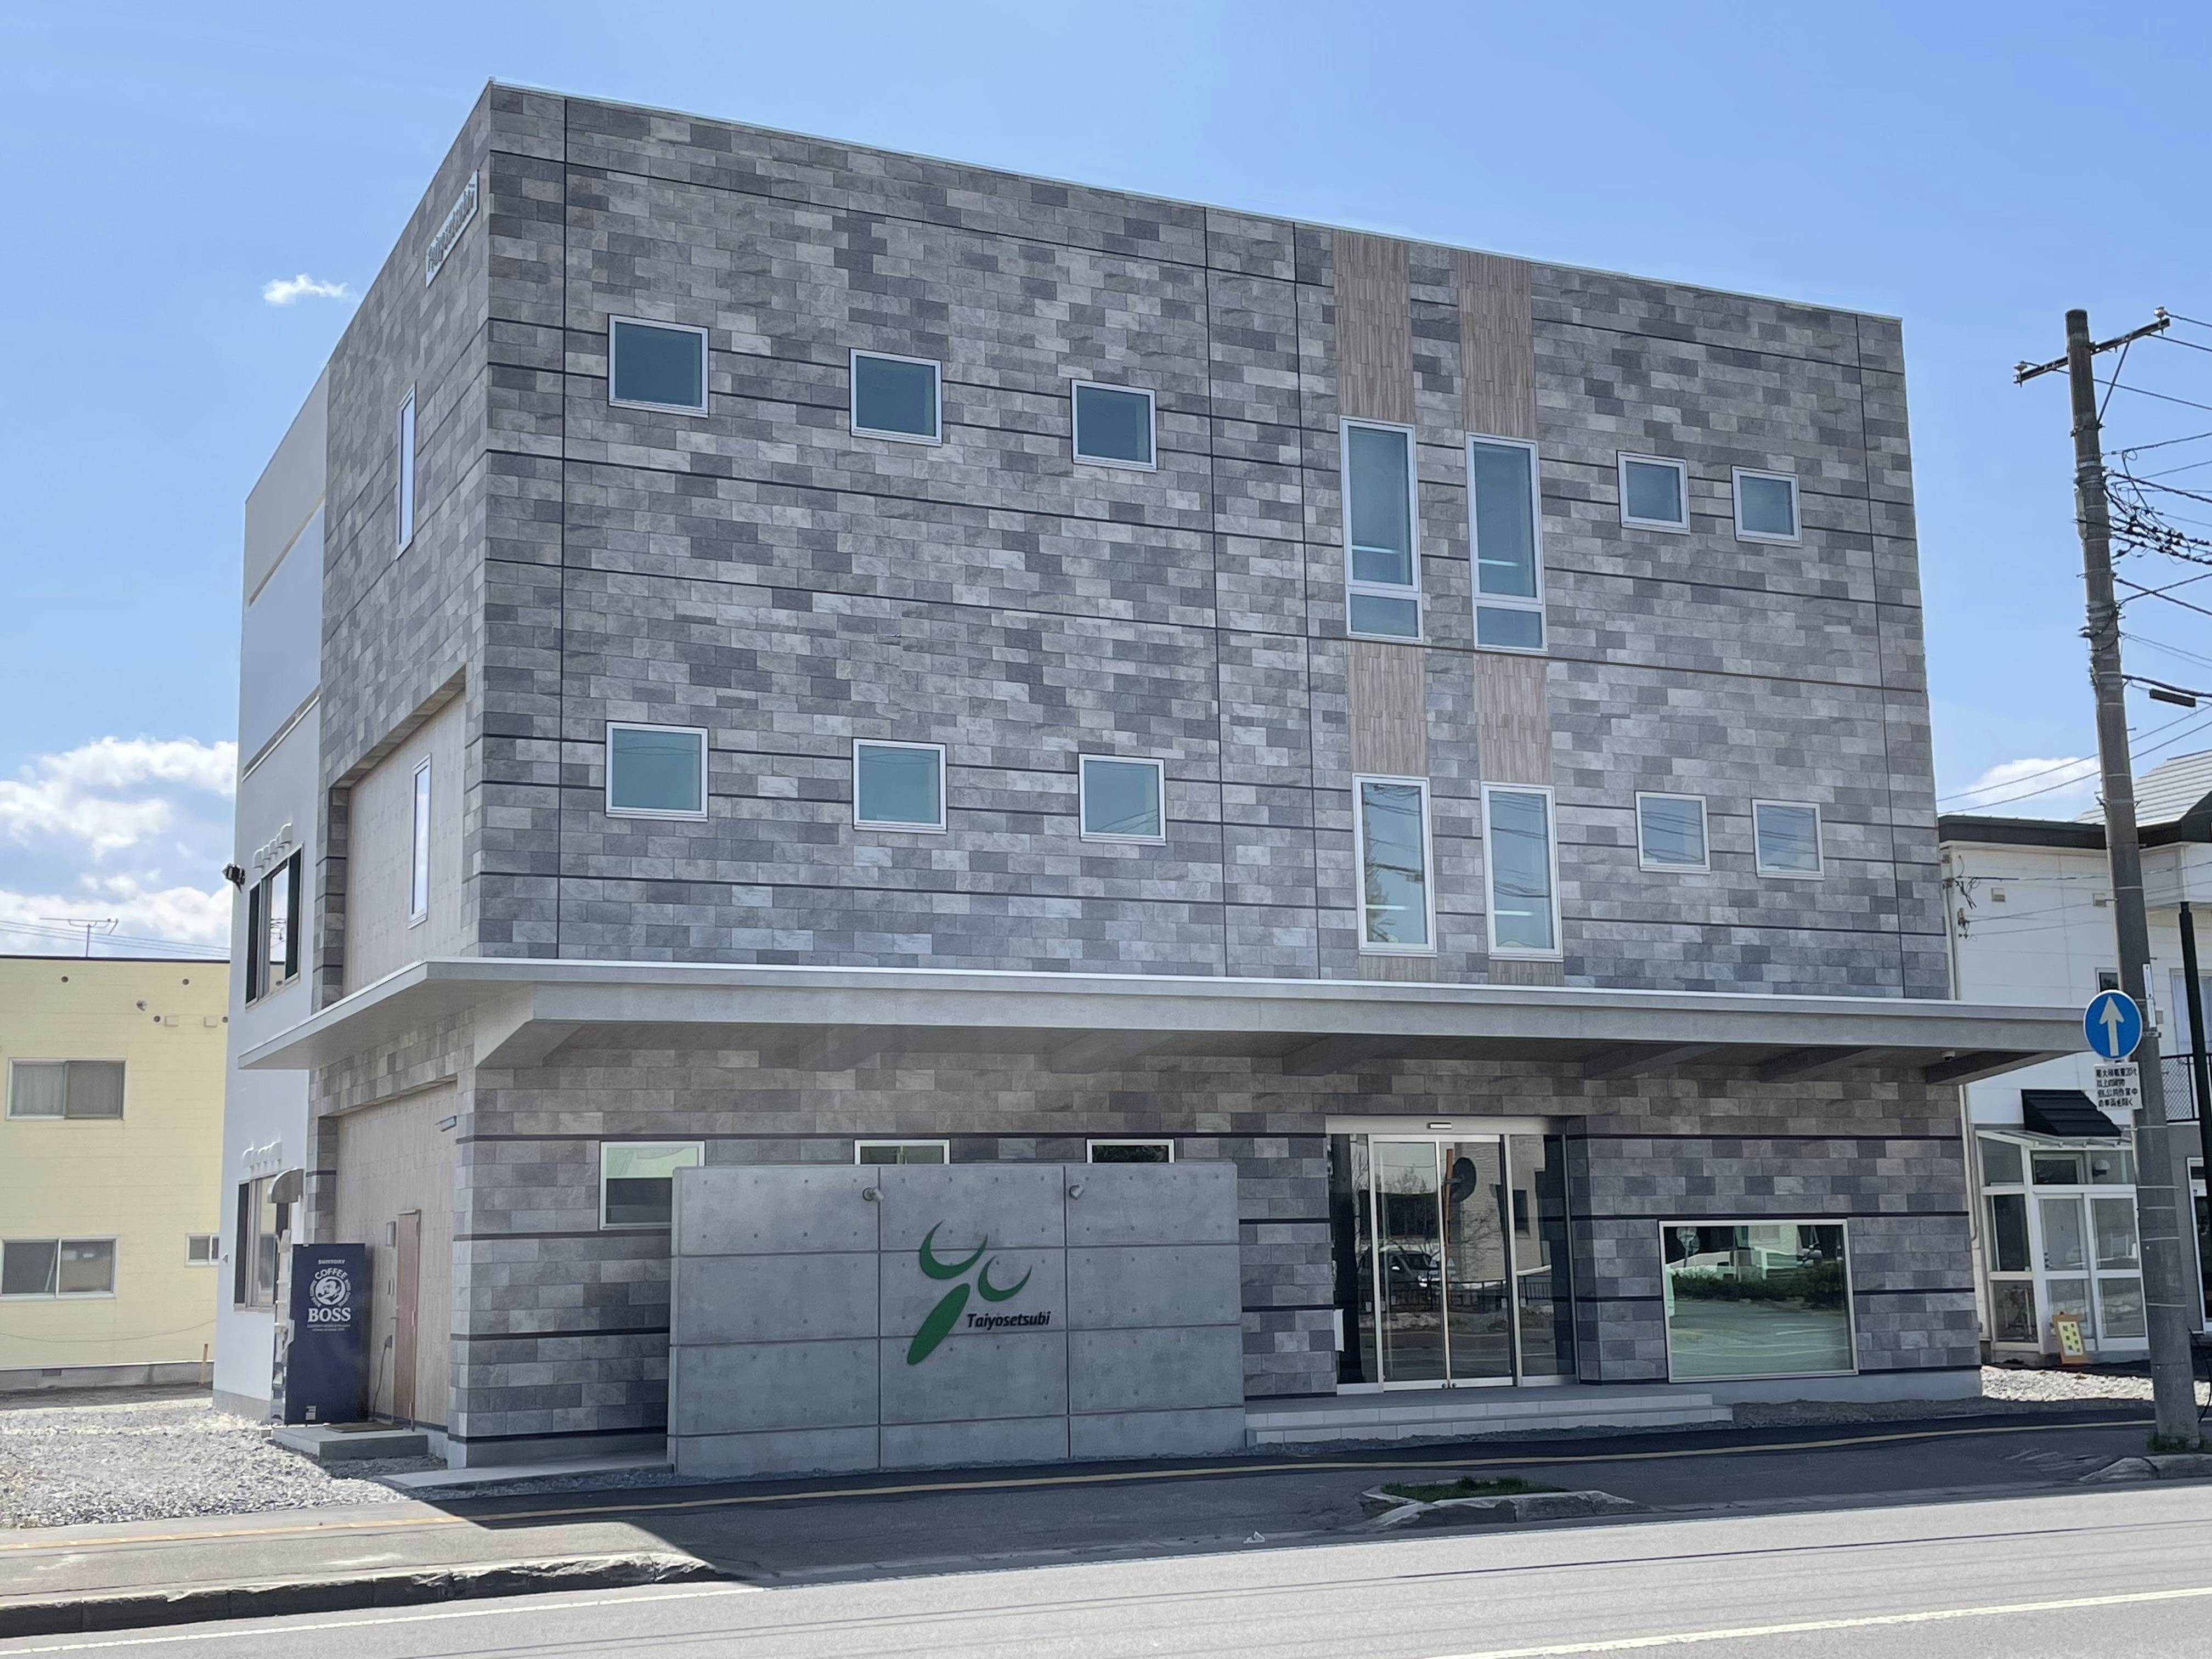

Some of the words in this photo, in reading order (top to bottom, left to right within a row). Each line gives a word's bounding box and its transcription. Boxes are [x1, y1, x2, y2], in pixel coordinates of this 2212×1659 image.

[315, 1267, 348, 1280] COFFEE
[307, 1307, 351, 1323] BOSS
[967, 1311, 1051, 1330] Taiyosetsubi
